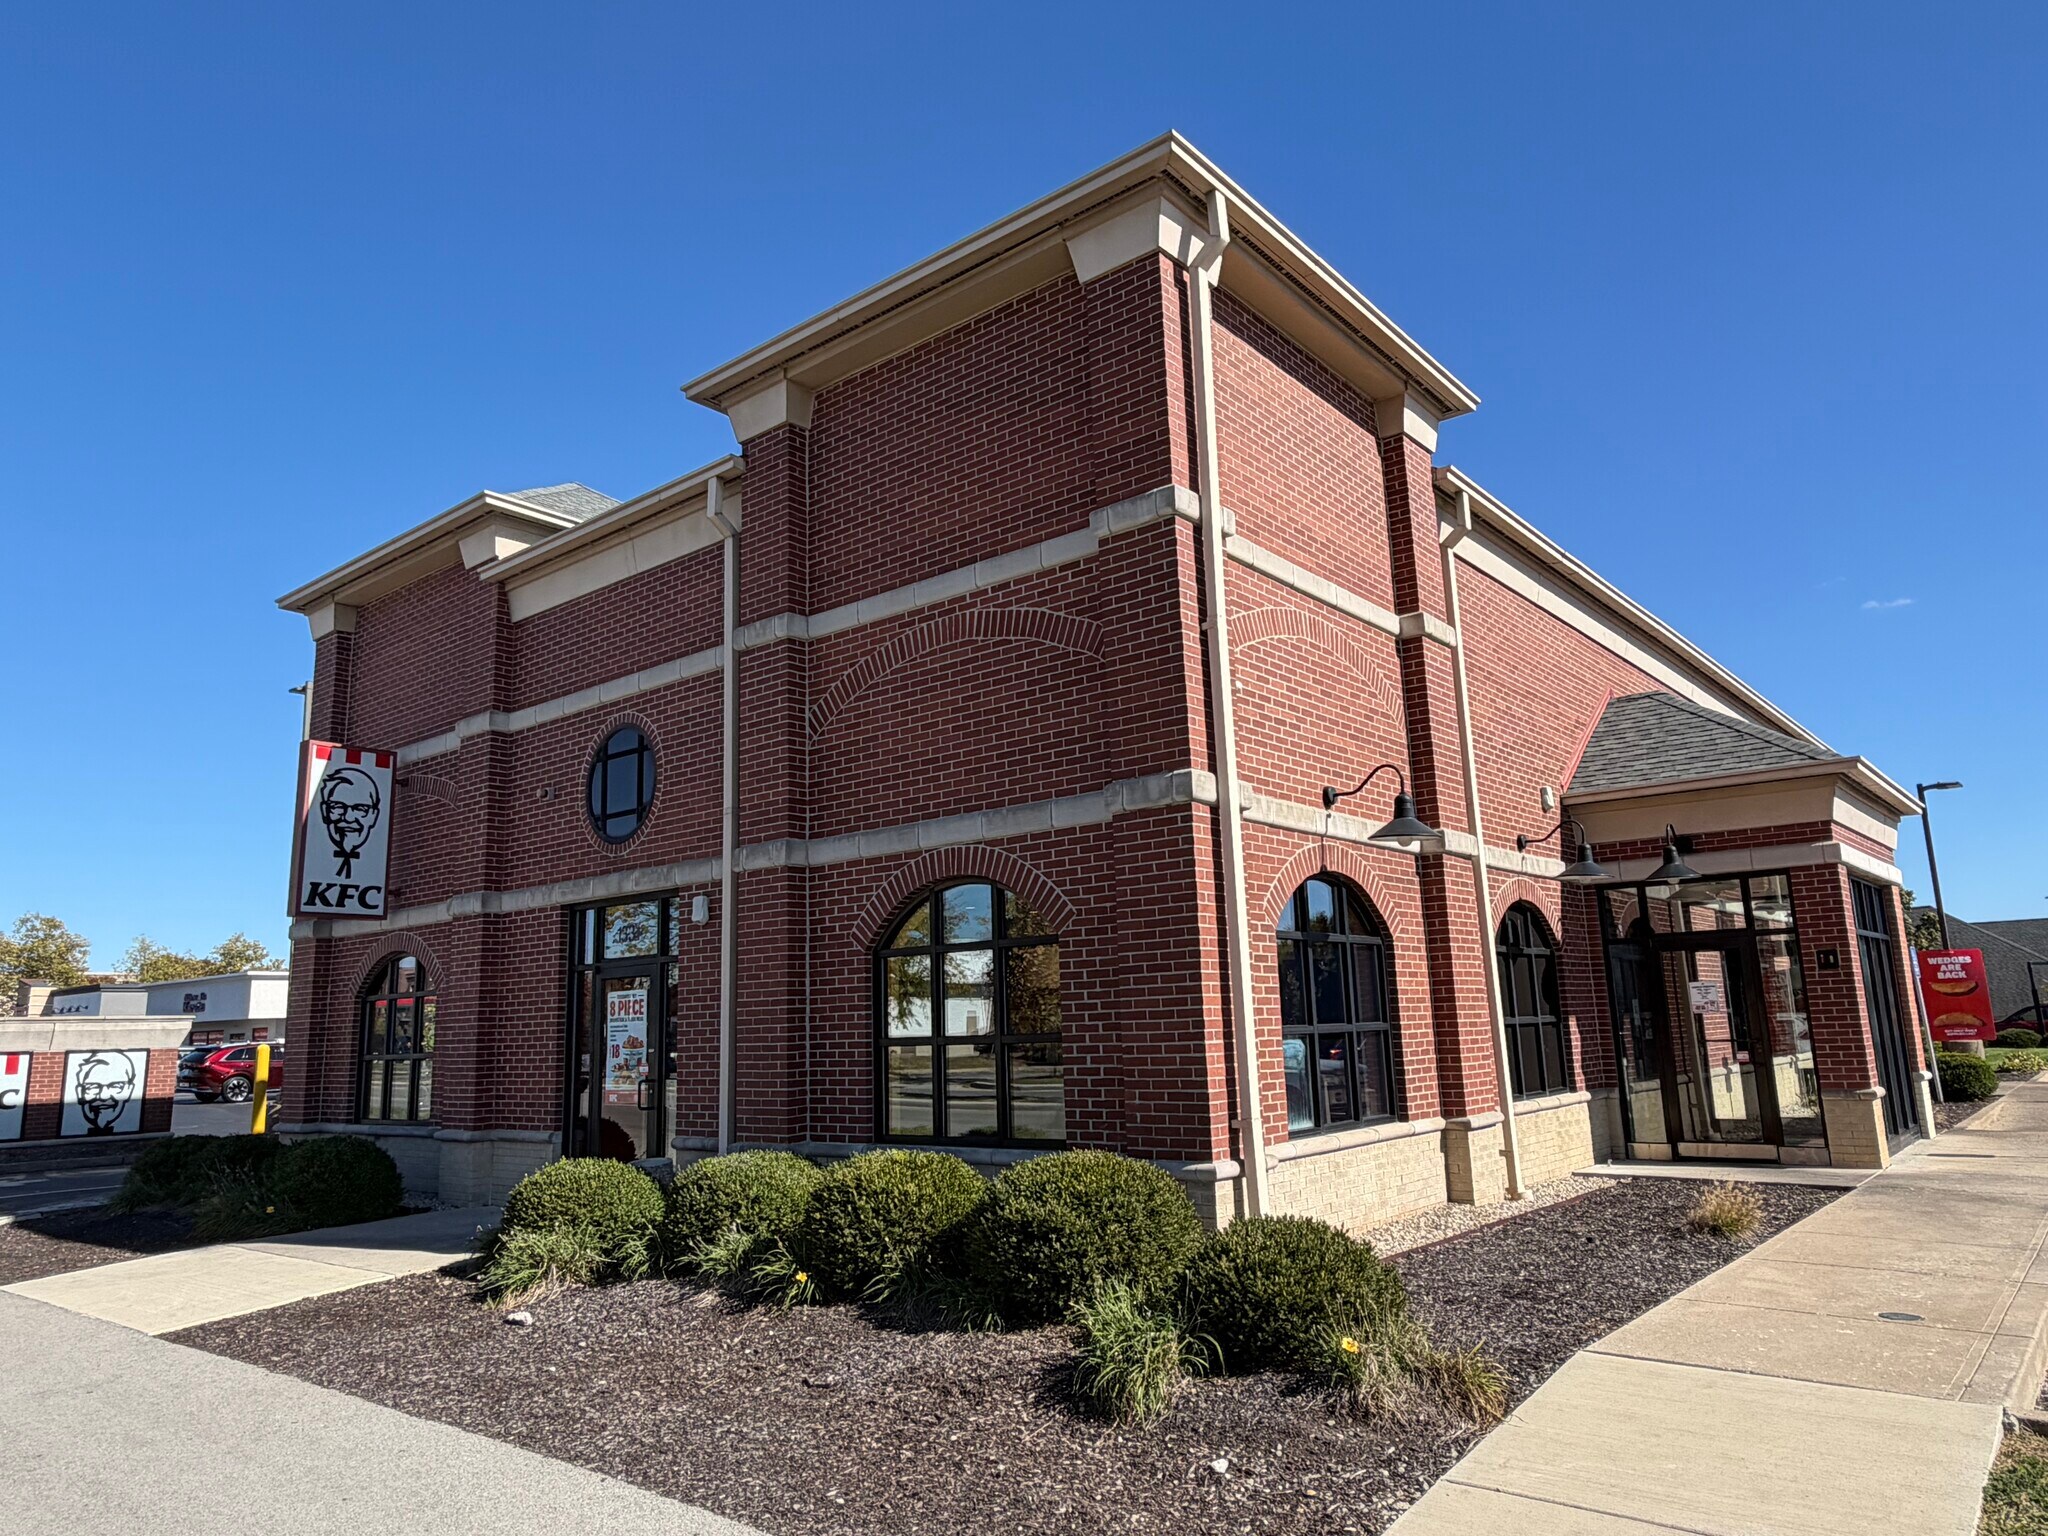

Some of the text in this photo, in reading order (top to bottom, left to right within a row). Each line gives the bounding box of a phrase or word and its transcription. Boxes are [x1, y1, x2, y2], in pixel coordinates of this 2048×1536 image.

[303, 881, 382, 909] KFC
[1927, 956, 1972, 964] WEDGES
[1937, 971, 1967, 979] BACK
[609, 998, 644, 1017] 8 PIECE
